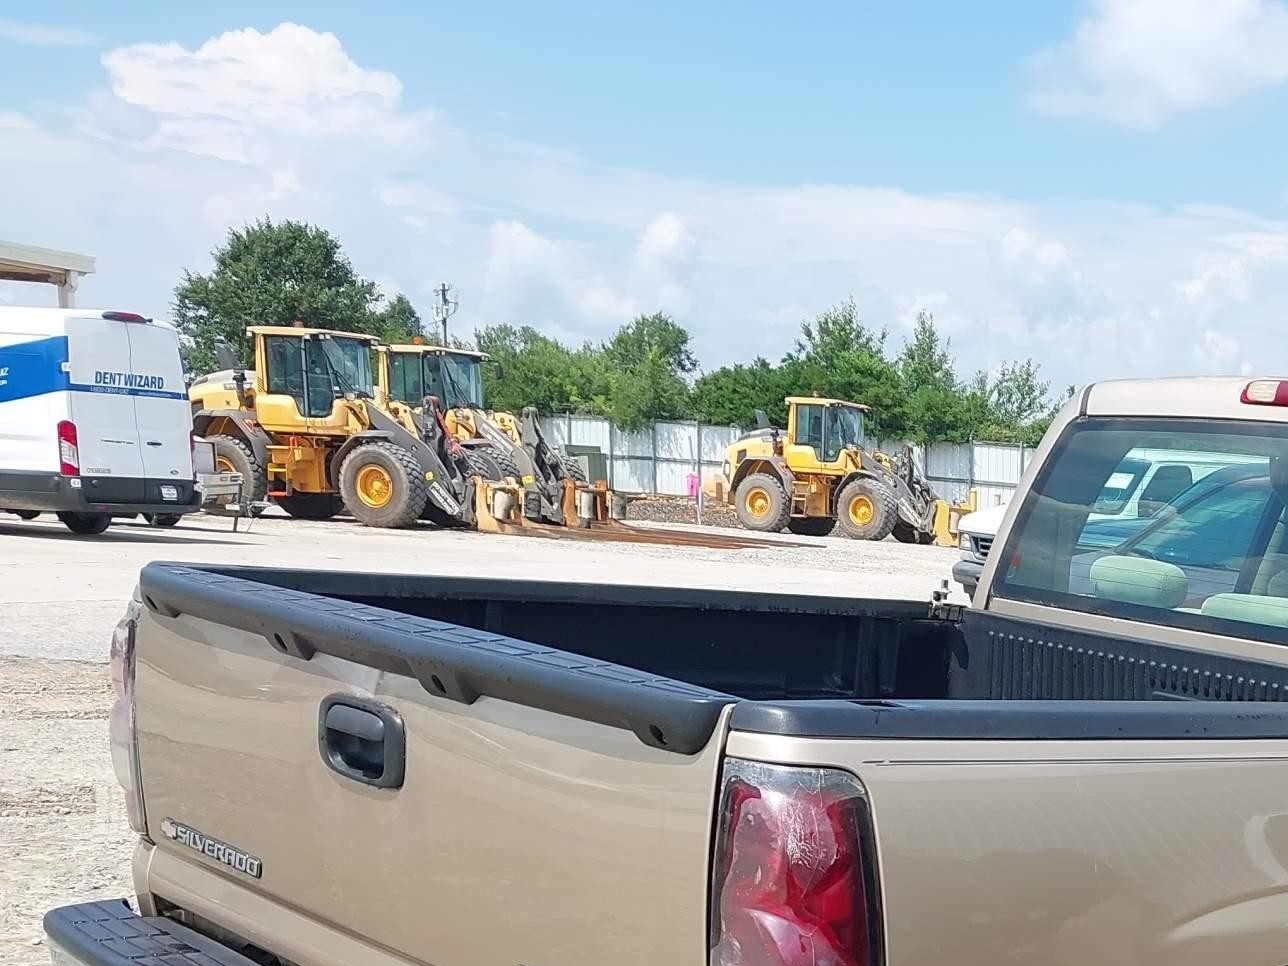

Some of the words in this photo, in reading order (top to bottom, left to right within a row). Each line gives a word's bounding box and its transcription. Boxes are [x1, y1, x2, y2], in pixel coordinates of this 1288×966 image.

[95, 371, 125, 386] DENT
[124, 374, 164, 390] WIZARD
[176, 825, 259, 878] SILVERADO
